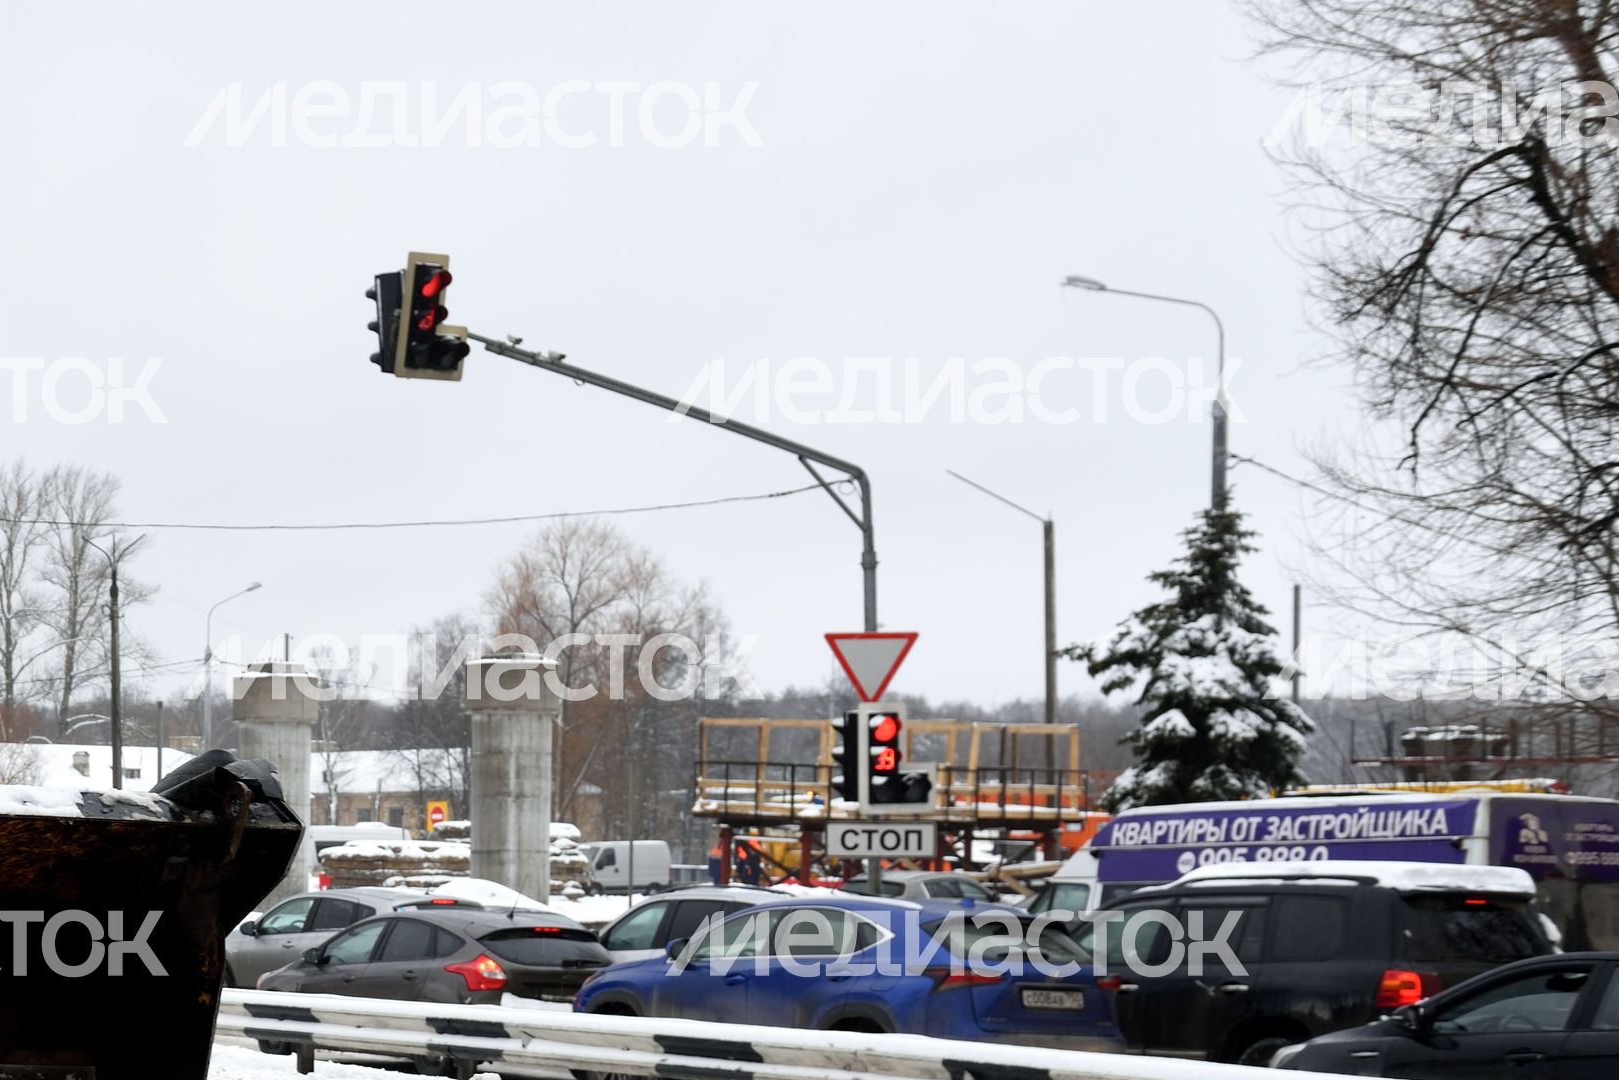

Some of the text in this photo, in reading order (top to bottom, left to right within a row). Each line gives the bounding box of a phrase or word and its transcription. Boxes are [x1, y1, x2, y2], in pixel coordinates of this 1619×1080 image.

[840, 829, 923, 851] СТОП
[1110, 807, 1448, 847] КВАРТИРЫ ОТ ЗАСТРОЙЩИКА
